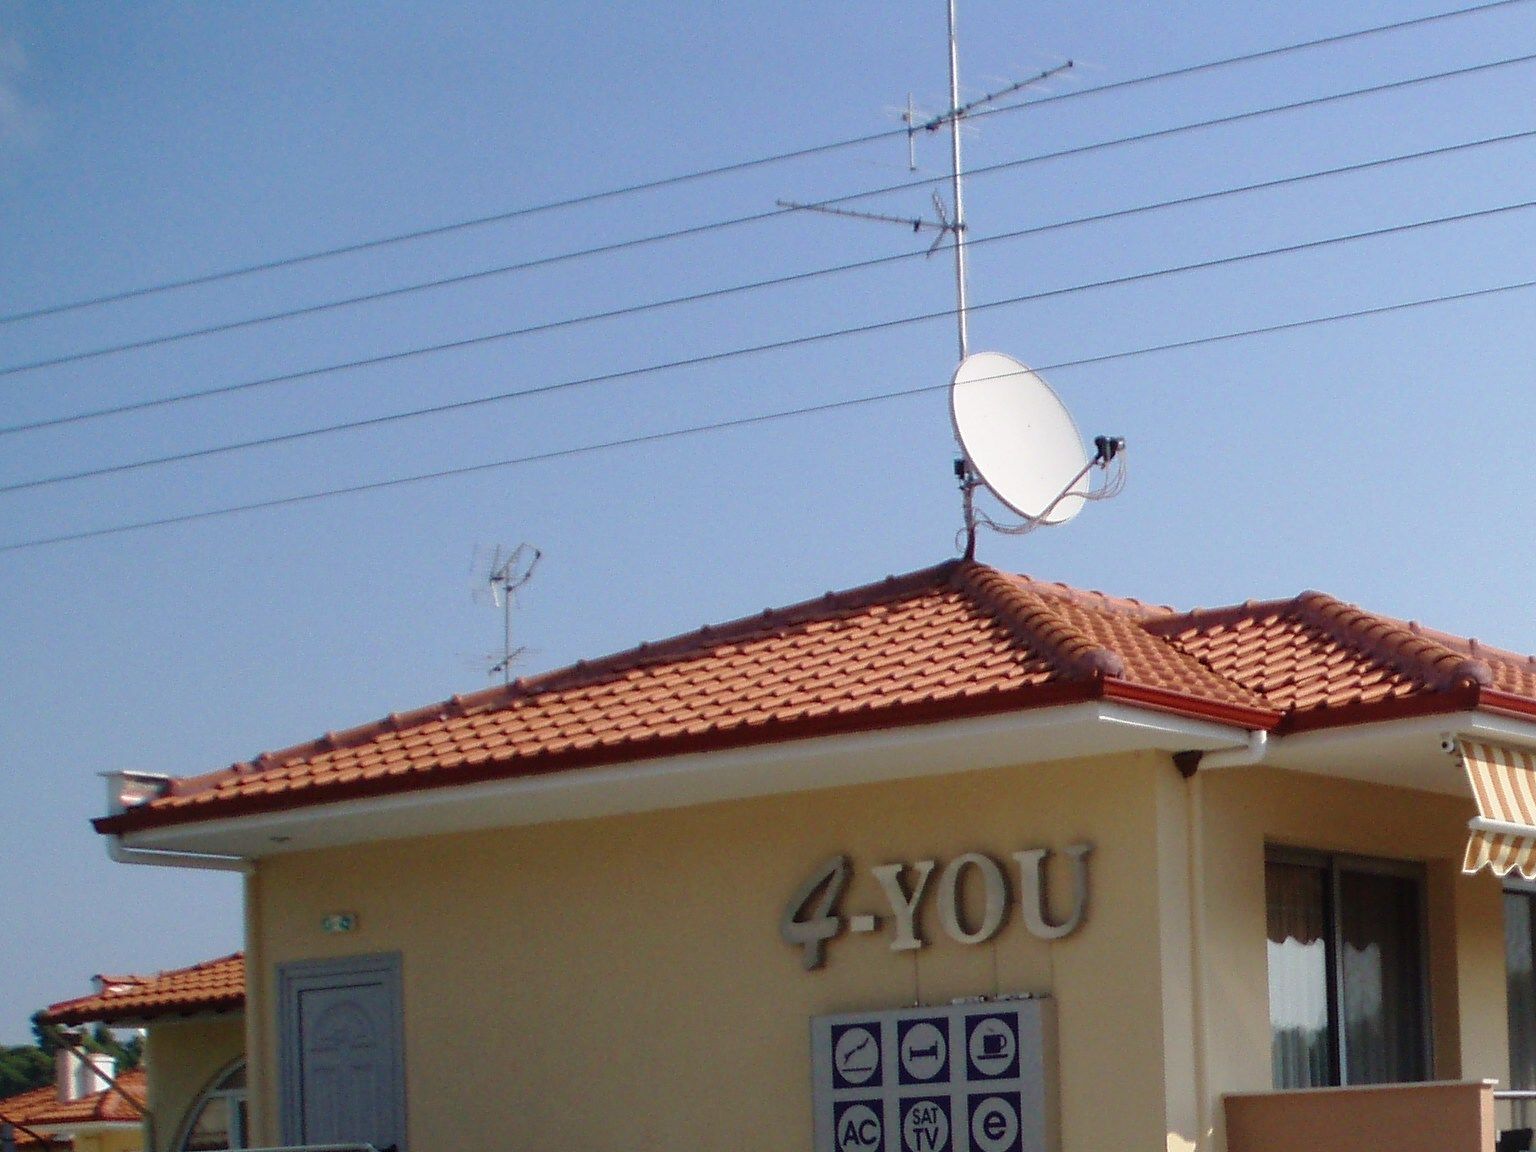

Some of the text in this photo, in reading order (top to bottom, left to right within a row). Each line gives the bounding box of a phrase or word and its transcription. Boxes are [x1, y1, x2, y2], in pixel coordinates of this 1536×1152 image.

[780, 844, 1092, 970] 4-YOU
[912, 1106, 939, 1127] SAT
[843, 1118, 878, 1147] AC
[912, 1128, 940, 1152] TV
